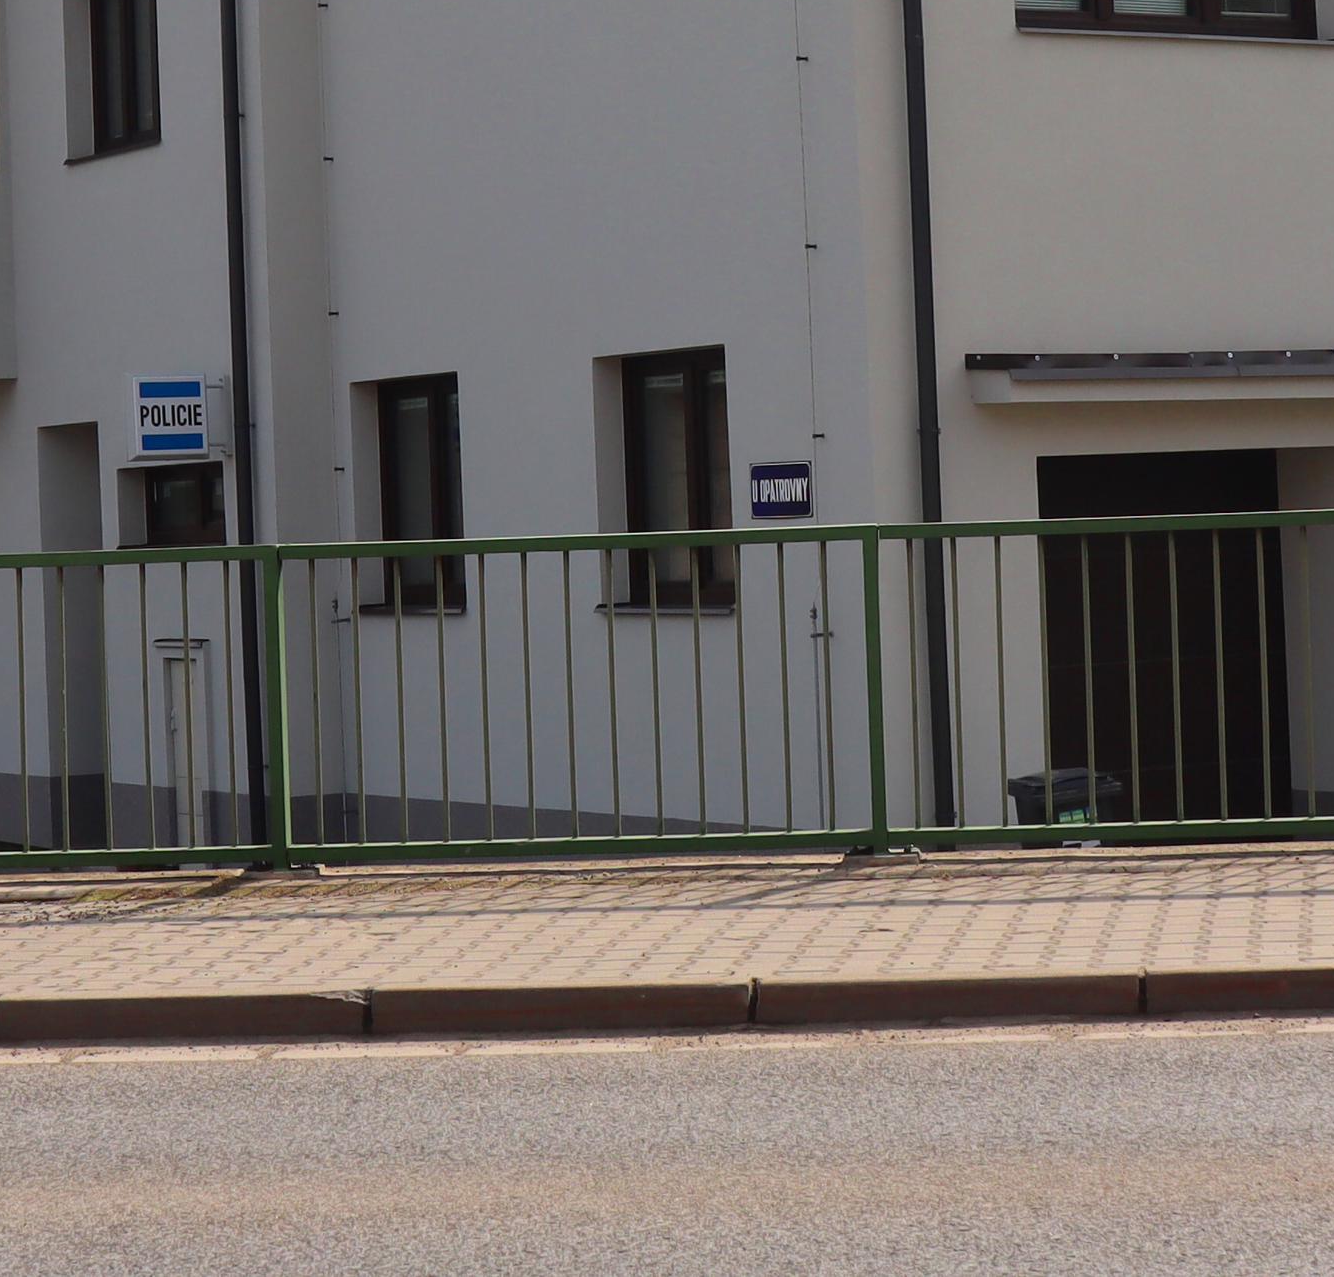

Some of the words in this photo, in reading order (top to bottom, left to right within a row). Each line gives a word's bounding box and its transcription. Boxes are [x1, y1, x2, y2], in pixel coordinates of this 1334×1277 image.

[140, 404, 203, 427] POLICIE
[752, 479, 758, 503] U
[759, 477, 808, 503] OPATROVNY
